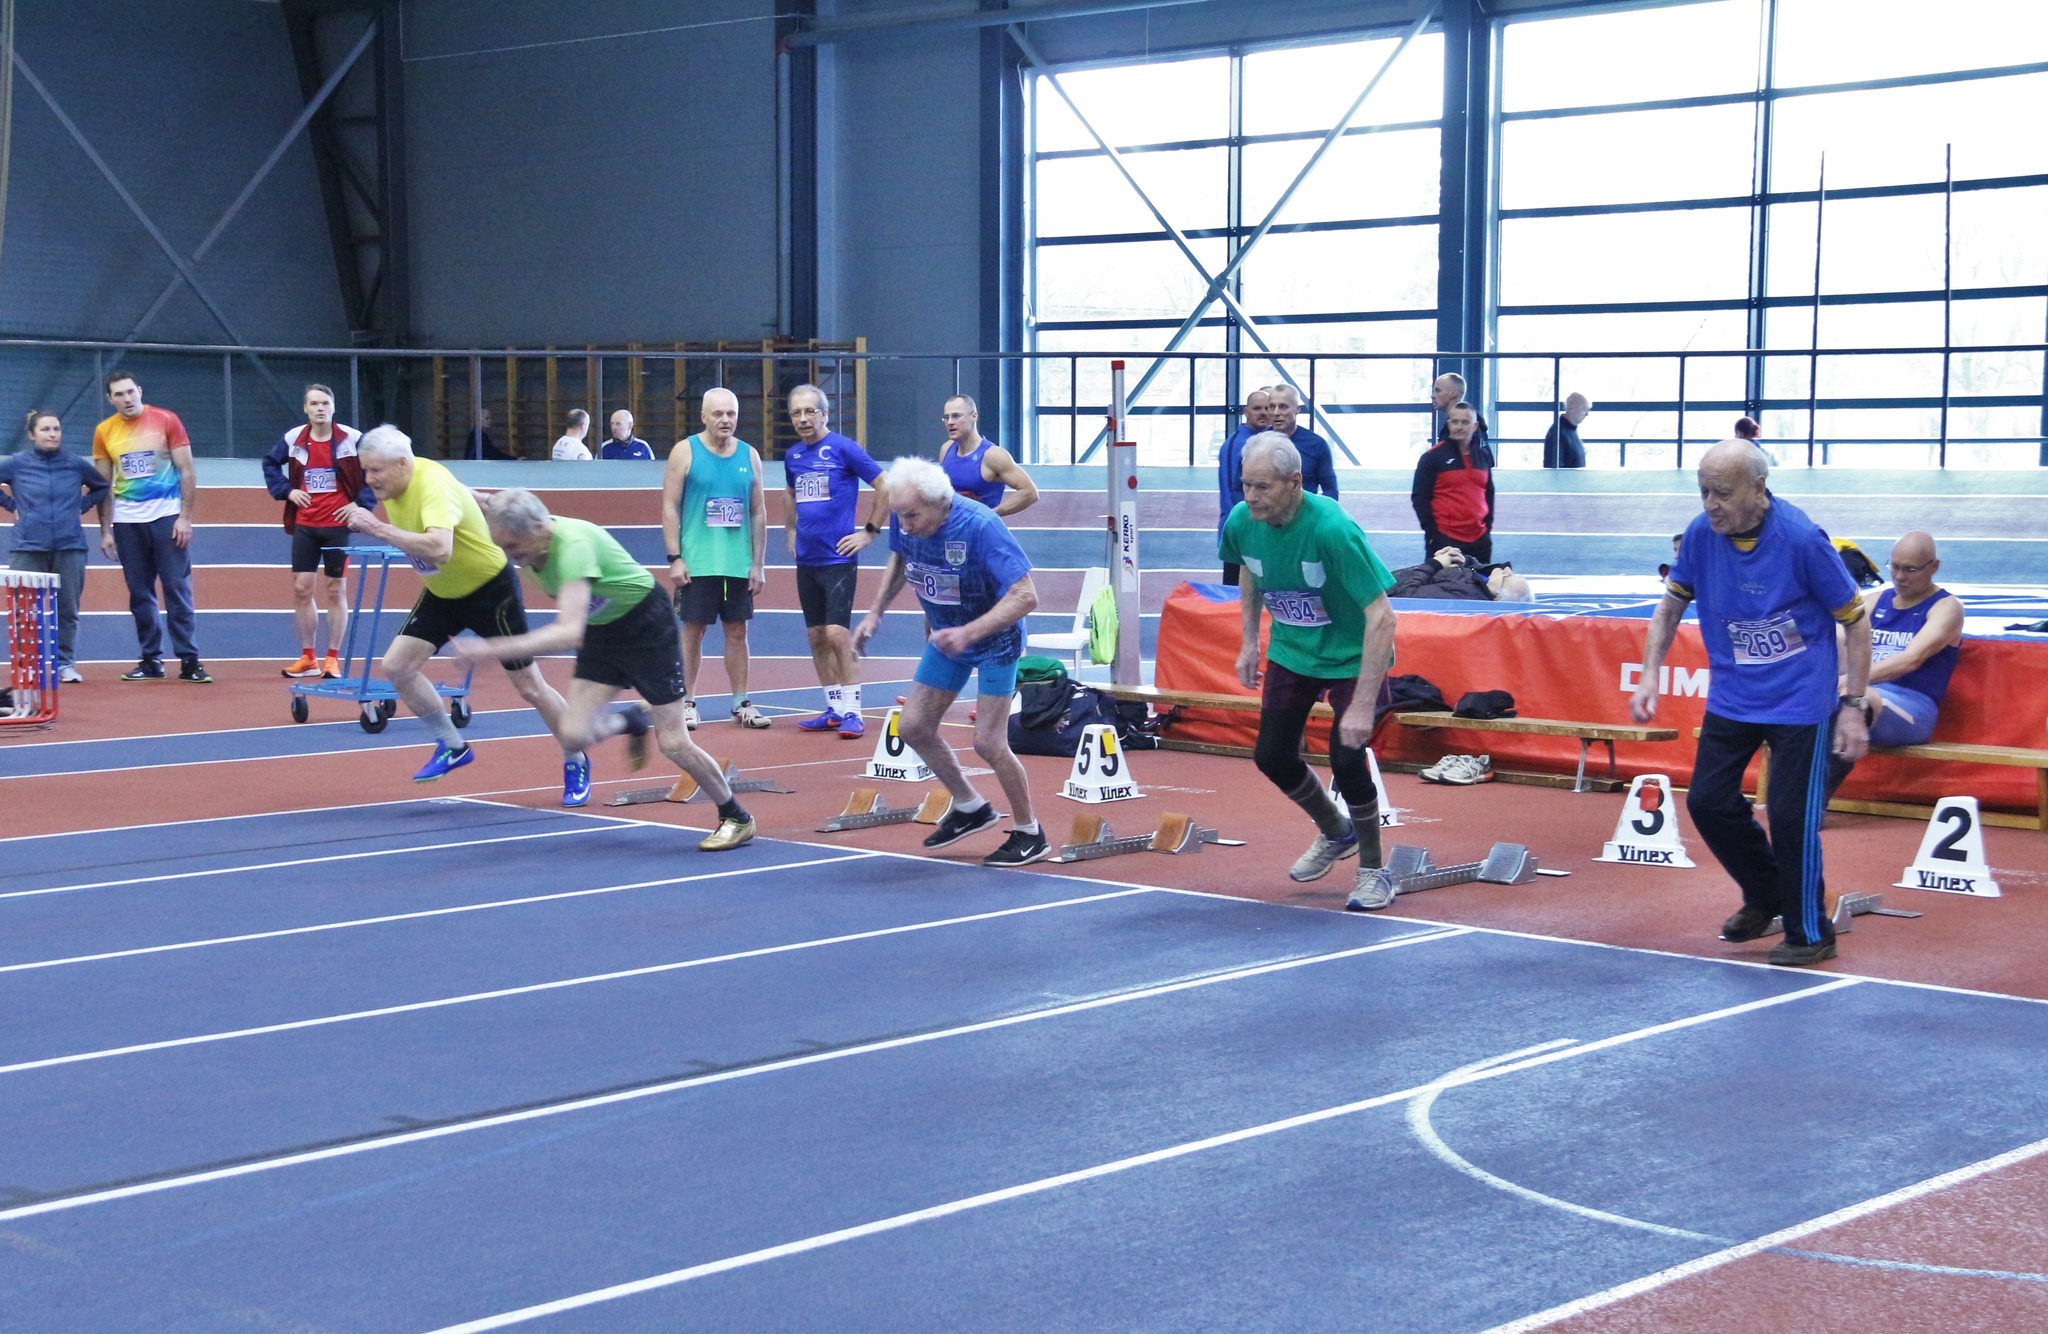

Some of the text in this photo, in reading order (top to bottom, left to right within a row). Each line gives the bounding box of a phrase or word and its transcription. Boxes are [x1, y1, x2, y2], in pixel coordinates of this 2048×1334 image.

[130, 459, 146, 474] 58
[311, 475, 326, 489] 62
[802, 480, 821, 497] 161
[720, 505, 735, 522] 12
[1122, 514, 1130, 552] KERKO
[924, 574, 938, 598] 8
[1277, 600, 1316, 621] 154
[1740, 630, 1788, 658] 269
[1871, 629, 1914, 646] STONIA
[885, 719, 906, 757] 6
[1078, 732, 1094, 775] 5
[1100, 733, 1119, 777] 5
[874, 763, 908, 780] Vinex
[1068, 782, 1088, 800] Vinex
[1099, 785, 1132, 800] Vinex
[1631, 785, 1665, 836] 3
[1930, 806, 1972, 862] 2
[1617, 844, 1675, 864] Vinex
[1916, 869, 1977, 893] Vinex
